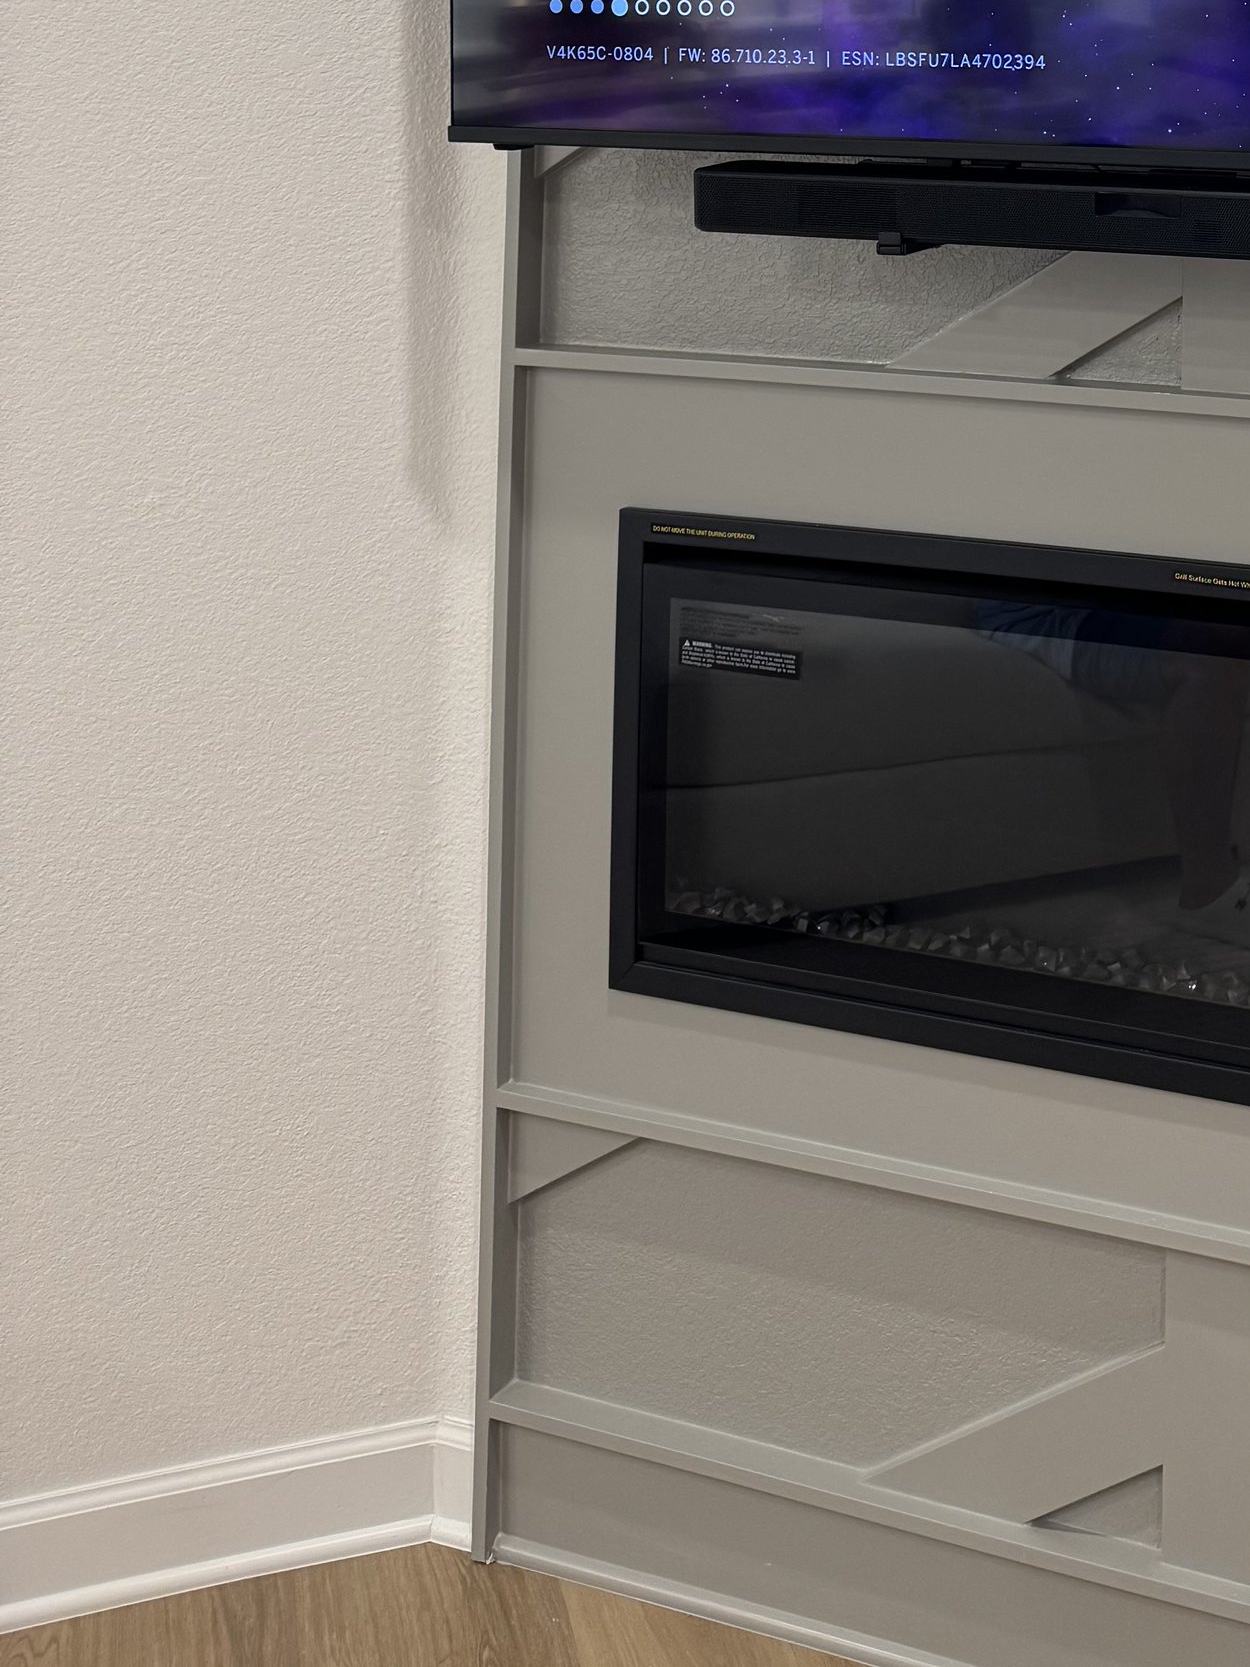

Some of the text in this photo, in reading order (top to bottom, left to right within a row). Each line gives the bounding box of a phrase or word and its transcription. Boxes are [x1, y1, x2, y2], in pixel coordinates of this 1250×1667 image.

[546, 45, 653, 61] V4K65C-0804
[679, 48, 705, 62] FW:
[711, 48, 815, 64] 86.710.23.3-1
[842, 51, 879, 66] ESN:
[886, 52, 1046, 70] LBSFU7LA4702394
